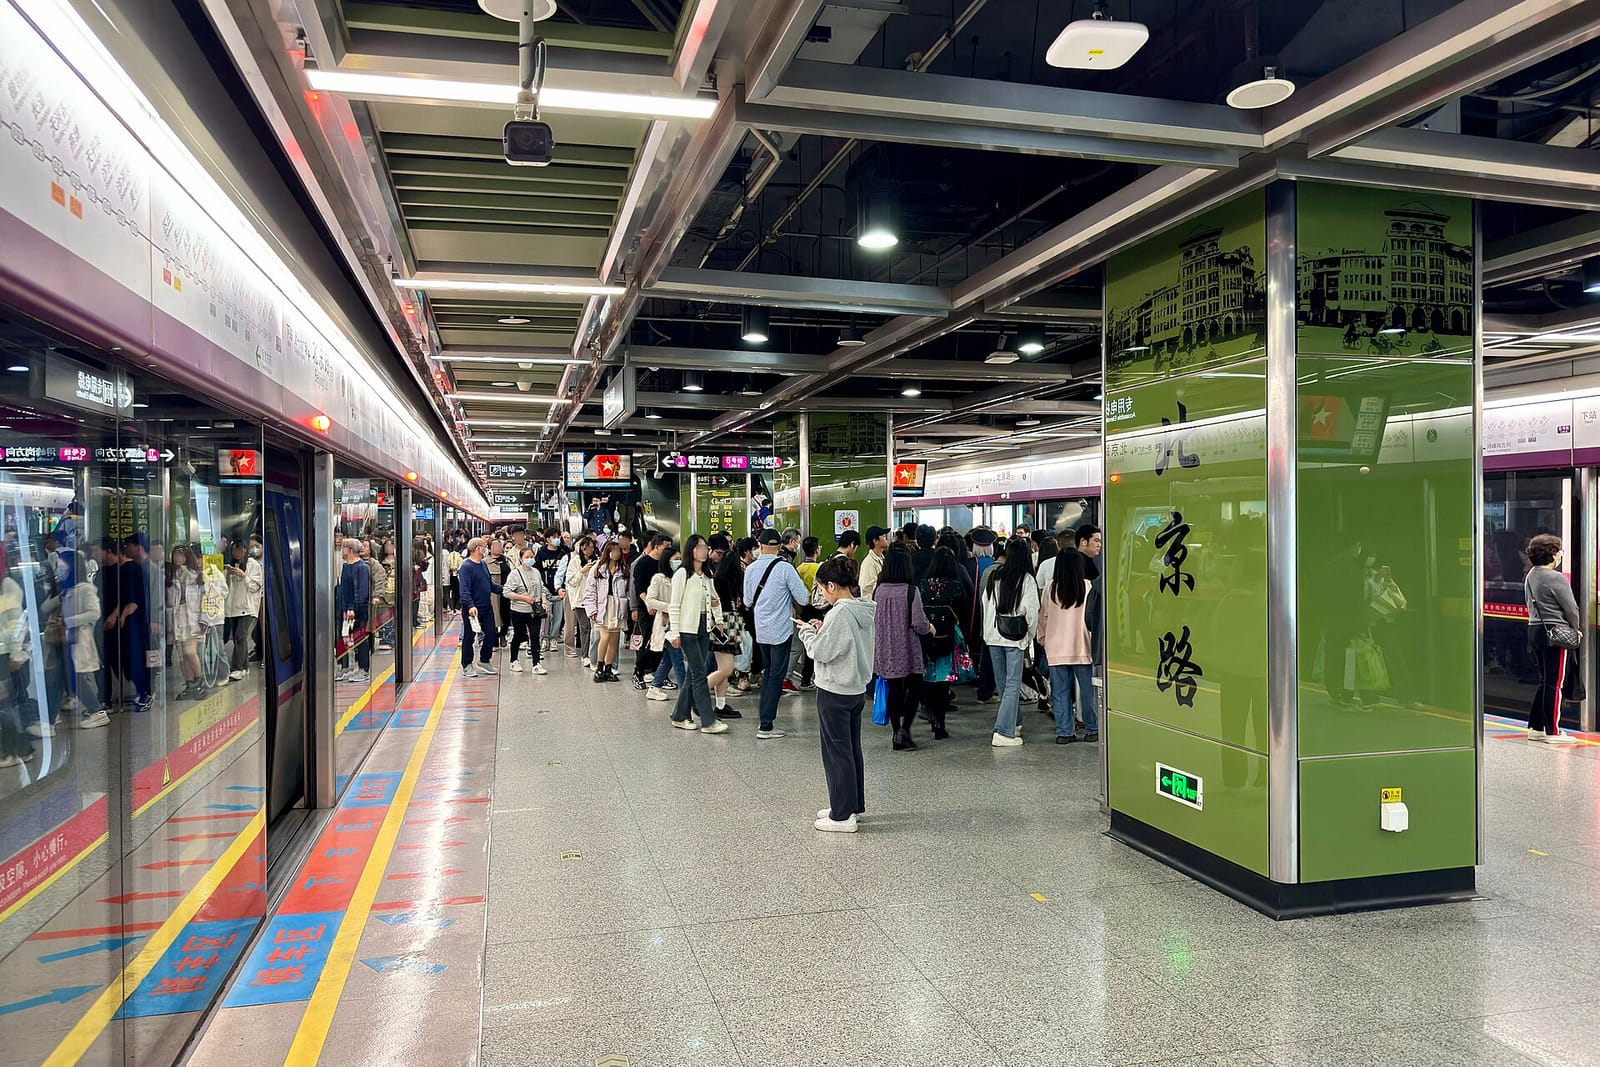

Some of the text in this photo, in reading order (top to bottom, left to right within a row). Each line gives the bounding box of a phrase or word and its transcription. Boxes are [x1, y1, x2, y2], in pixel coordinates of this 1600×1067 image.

[1155, 401, 1203, 708] 北京路
[250, 925, 326, 986] 候车区
